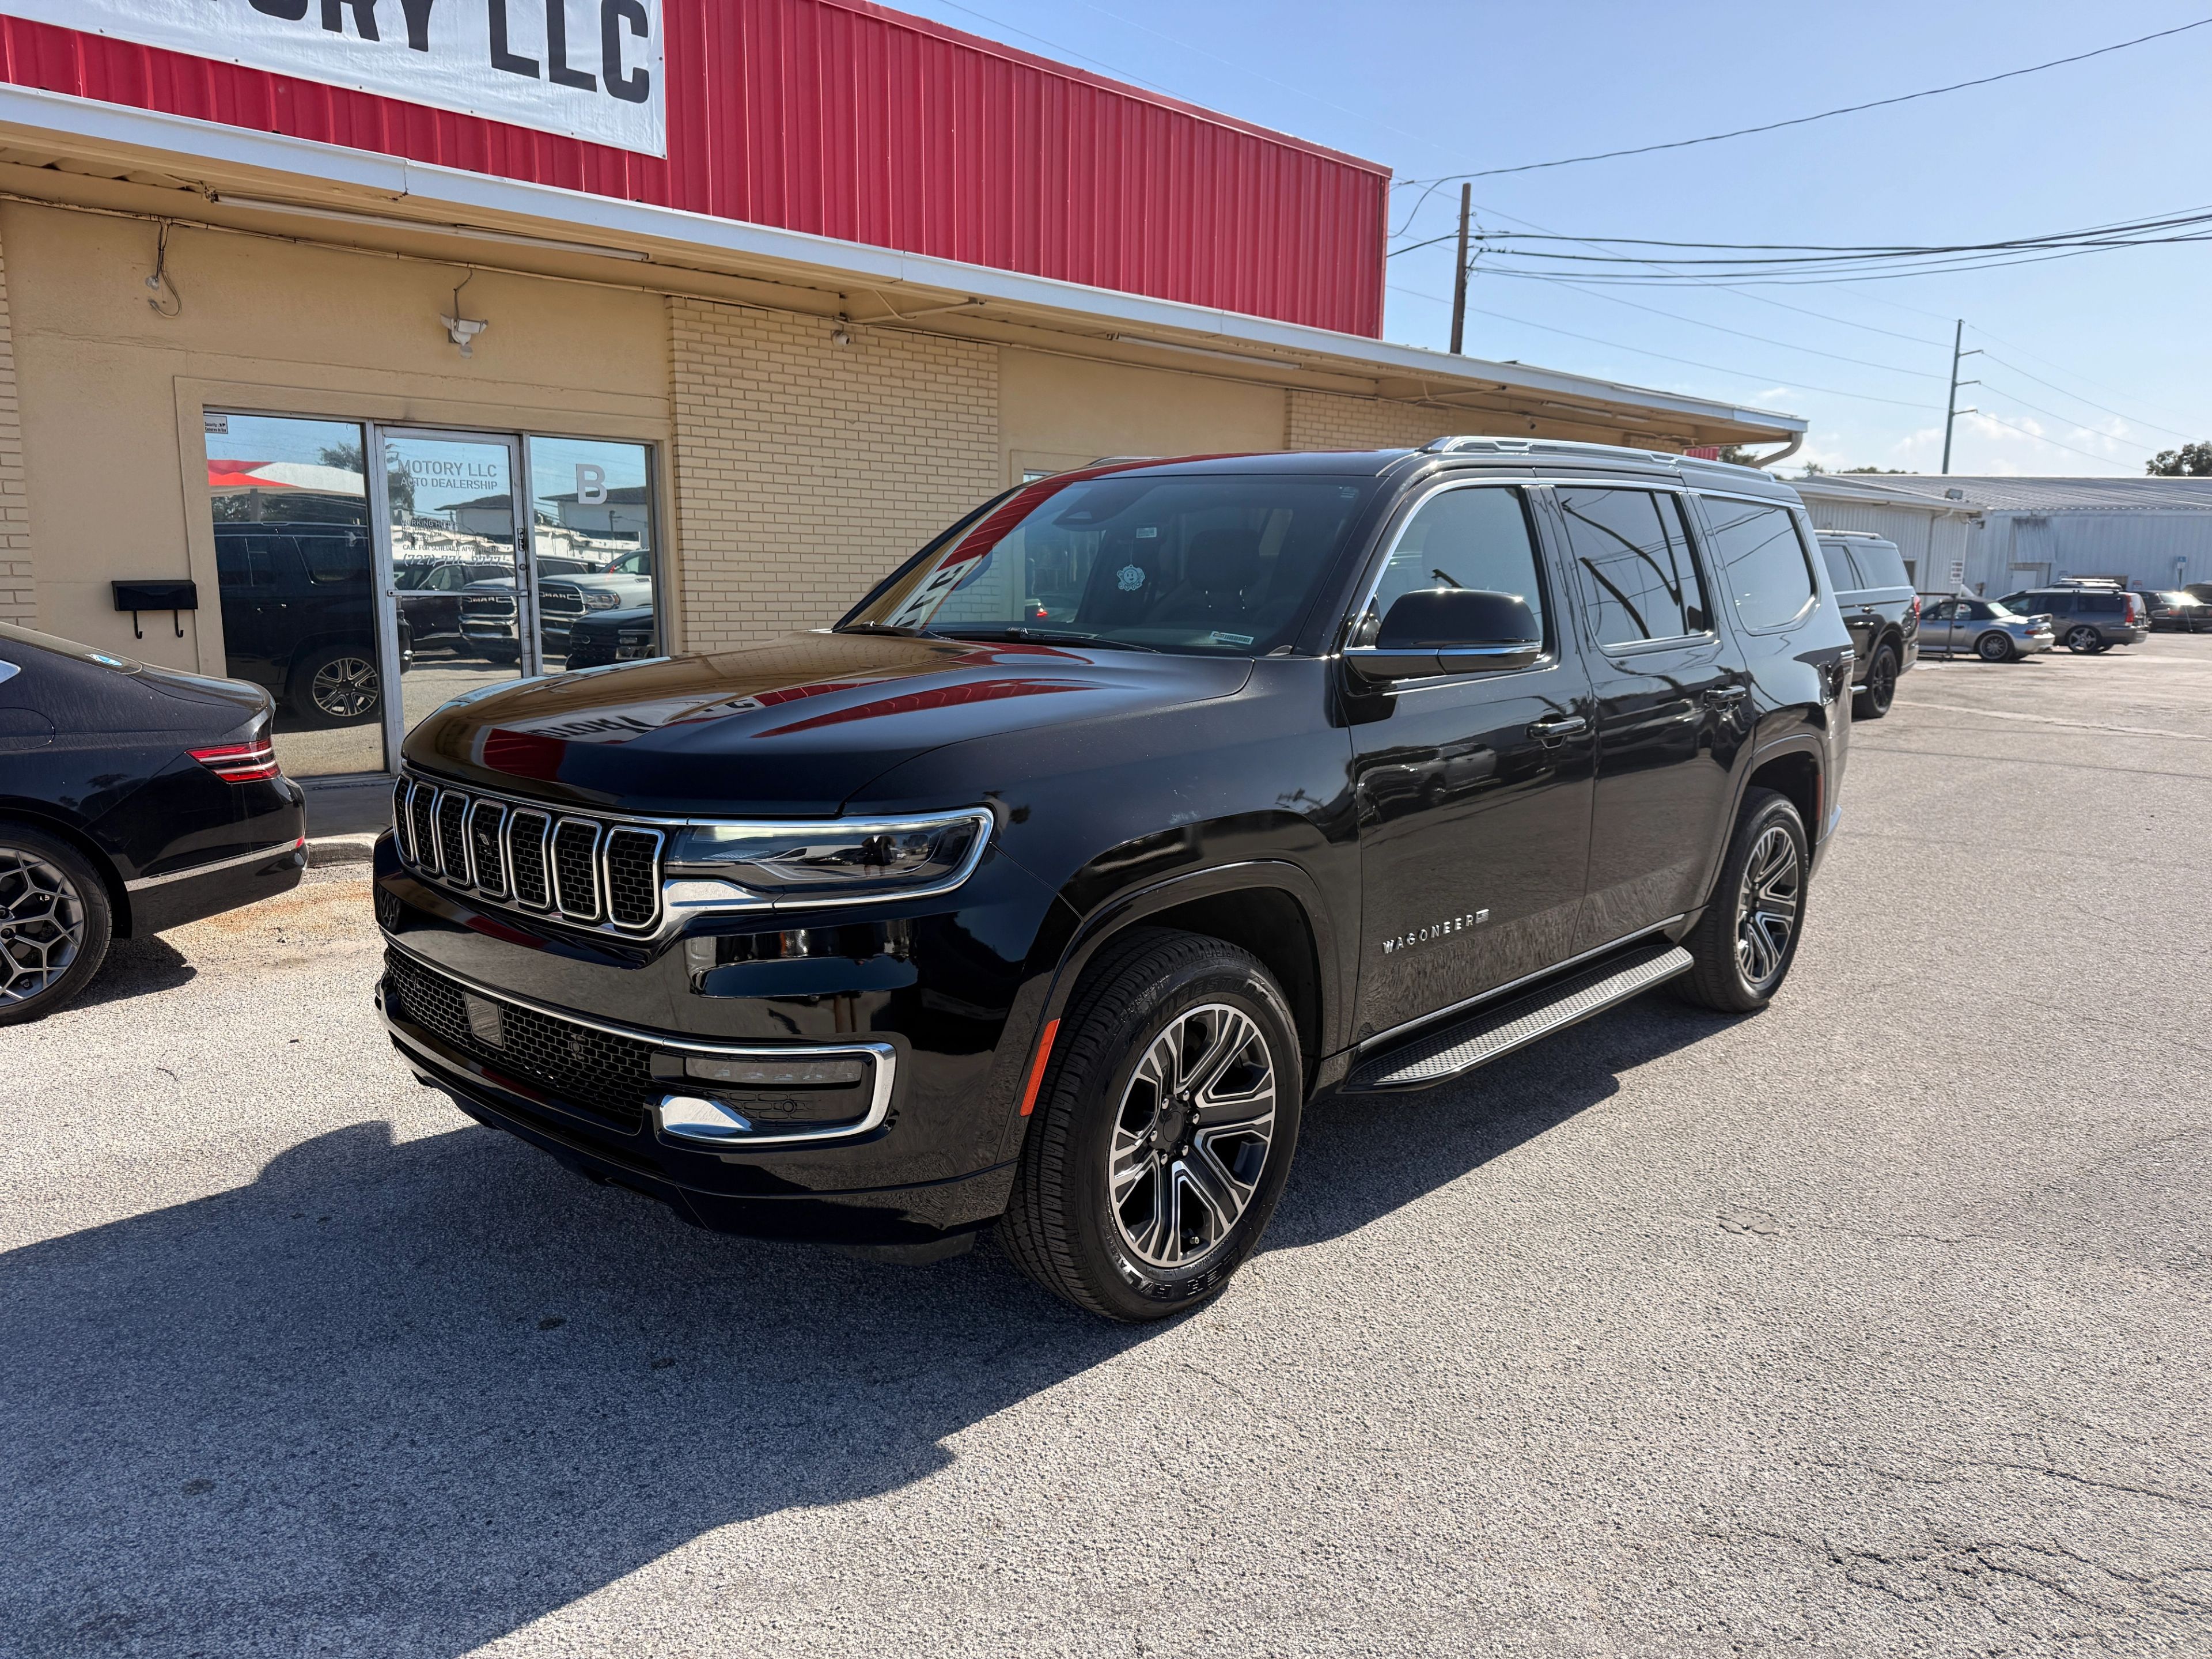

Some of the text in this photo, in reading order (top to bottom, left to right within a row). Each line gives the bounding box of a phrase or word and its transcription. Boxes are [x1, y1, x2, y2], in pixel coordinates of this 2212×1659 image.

[489, 0, 650, 104] LLC
[398, 459, 498, 478] MOTORY LLC
[400, 476, 498, 490] AUTO DEALERSHIP
[576, 463, 607, 505] B
[403, 553, 436, 567] (727)
[1382, 914, 1474, 955] WAGONEER
